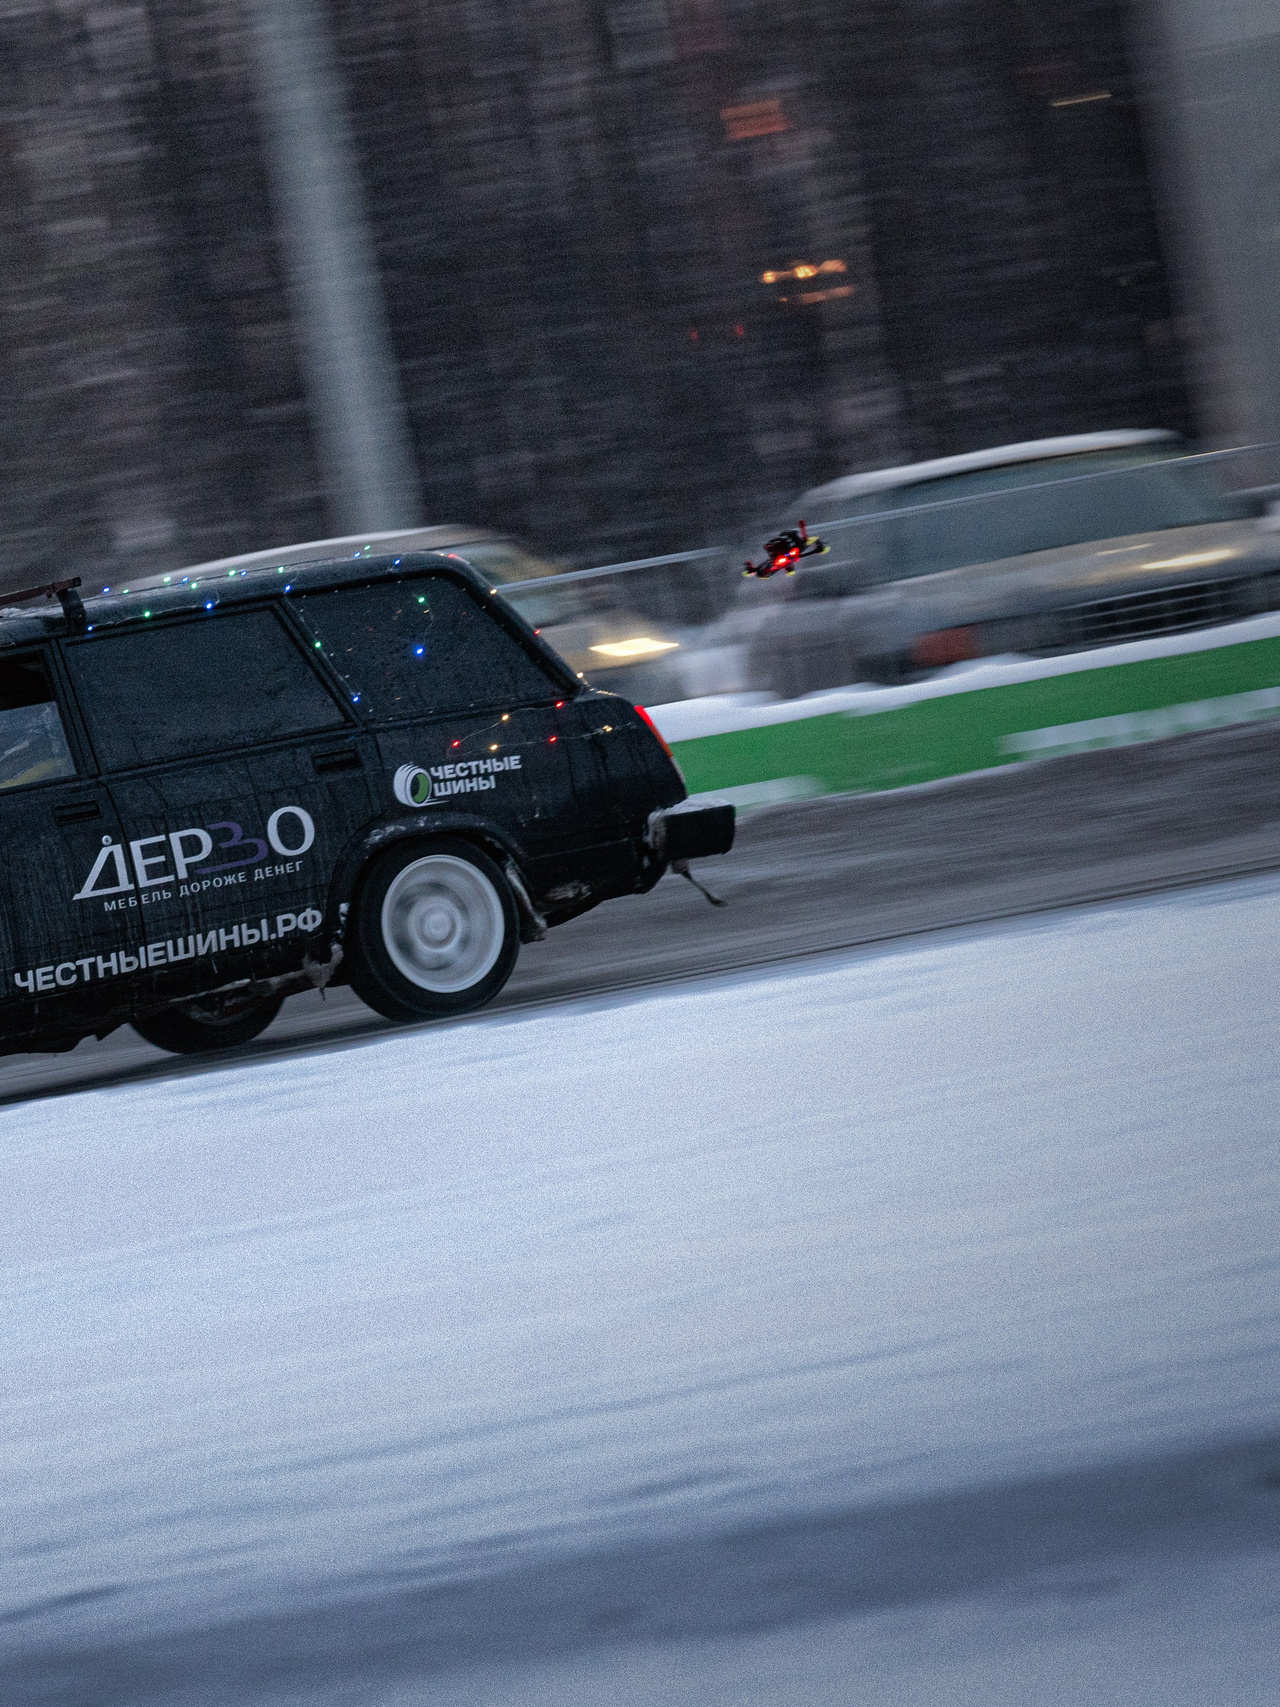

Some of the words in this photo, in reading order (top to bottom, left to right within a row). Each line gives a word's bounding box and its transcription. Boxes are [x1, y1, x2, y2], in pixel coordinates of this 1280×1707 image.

[429, 755, 522, 780] ЧЕСТНЫЕ
[432, 774, 496, 797] ШИНЫ
[104, 888, 172, 912] МЕБЕЛЬ
[179, 870, 247, 898] ДОРОЖЕ
[253, 860, 304, 882] ДЕНЕГ
[14, 908, 323, 993] ЧЕСТНЫЕШИНЫ.РФ
